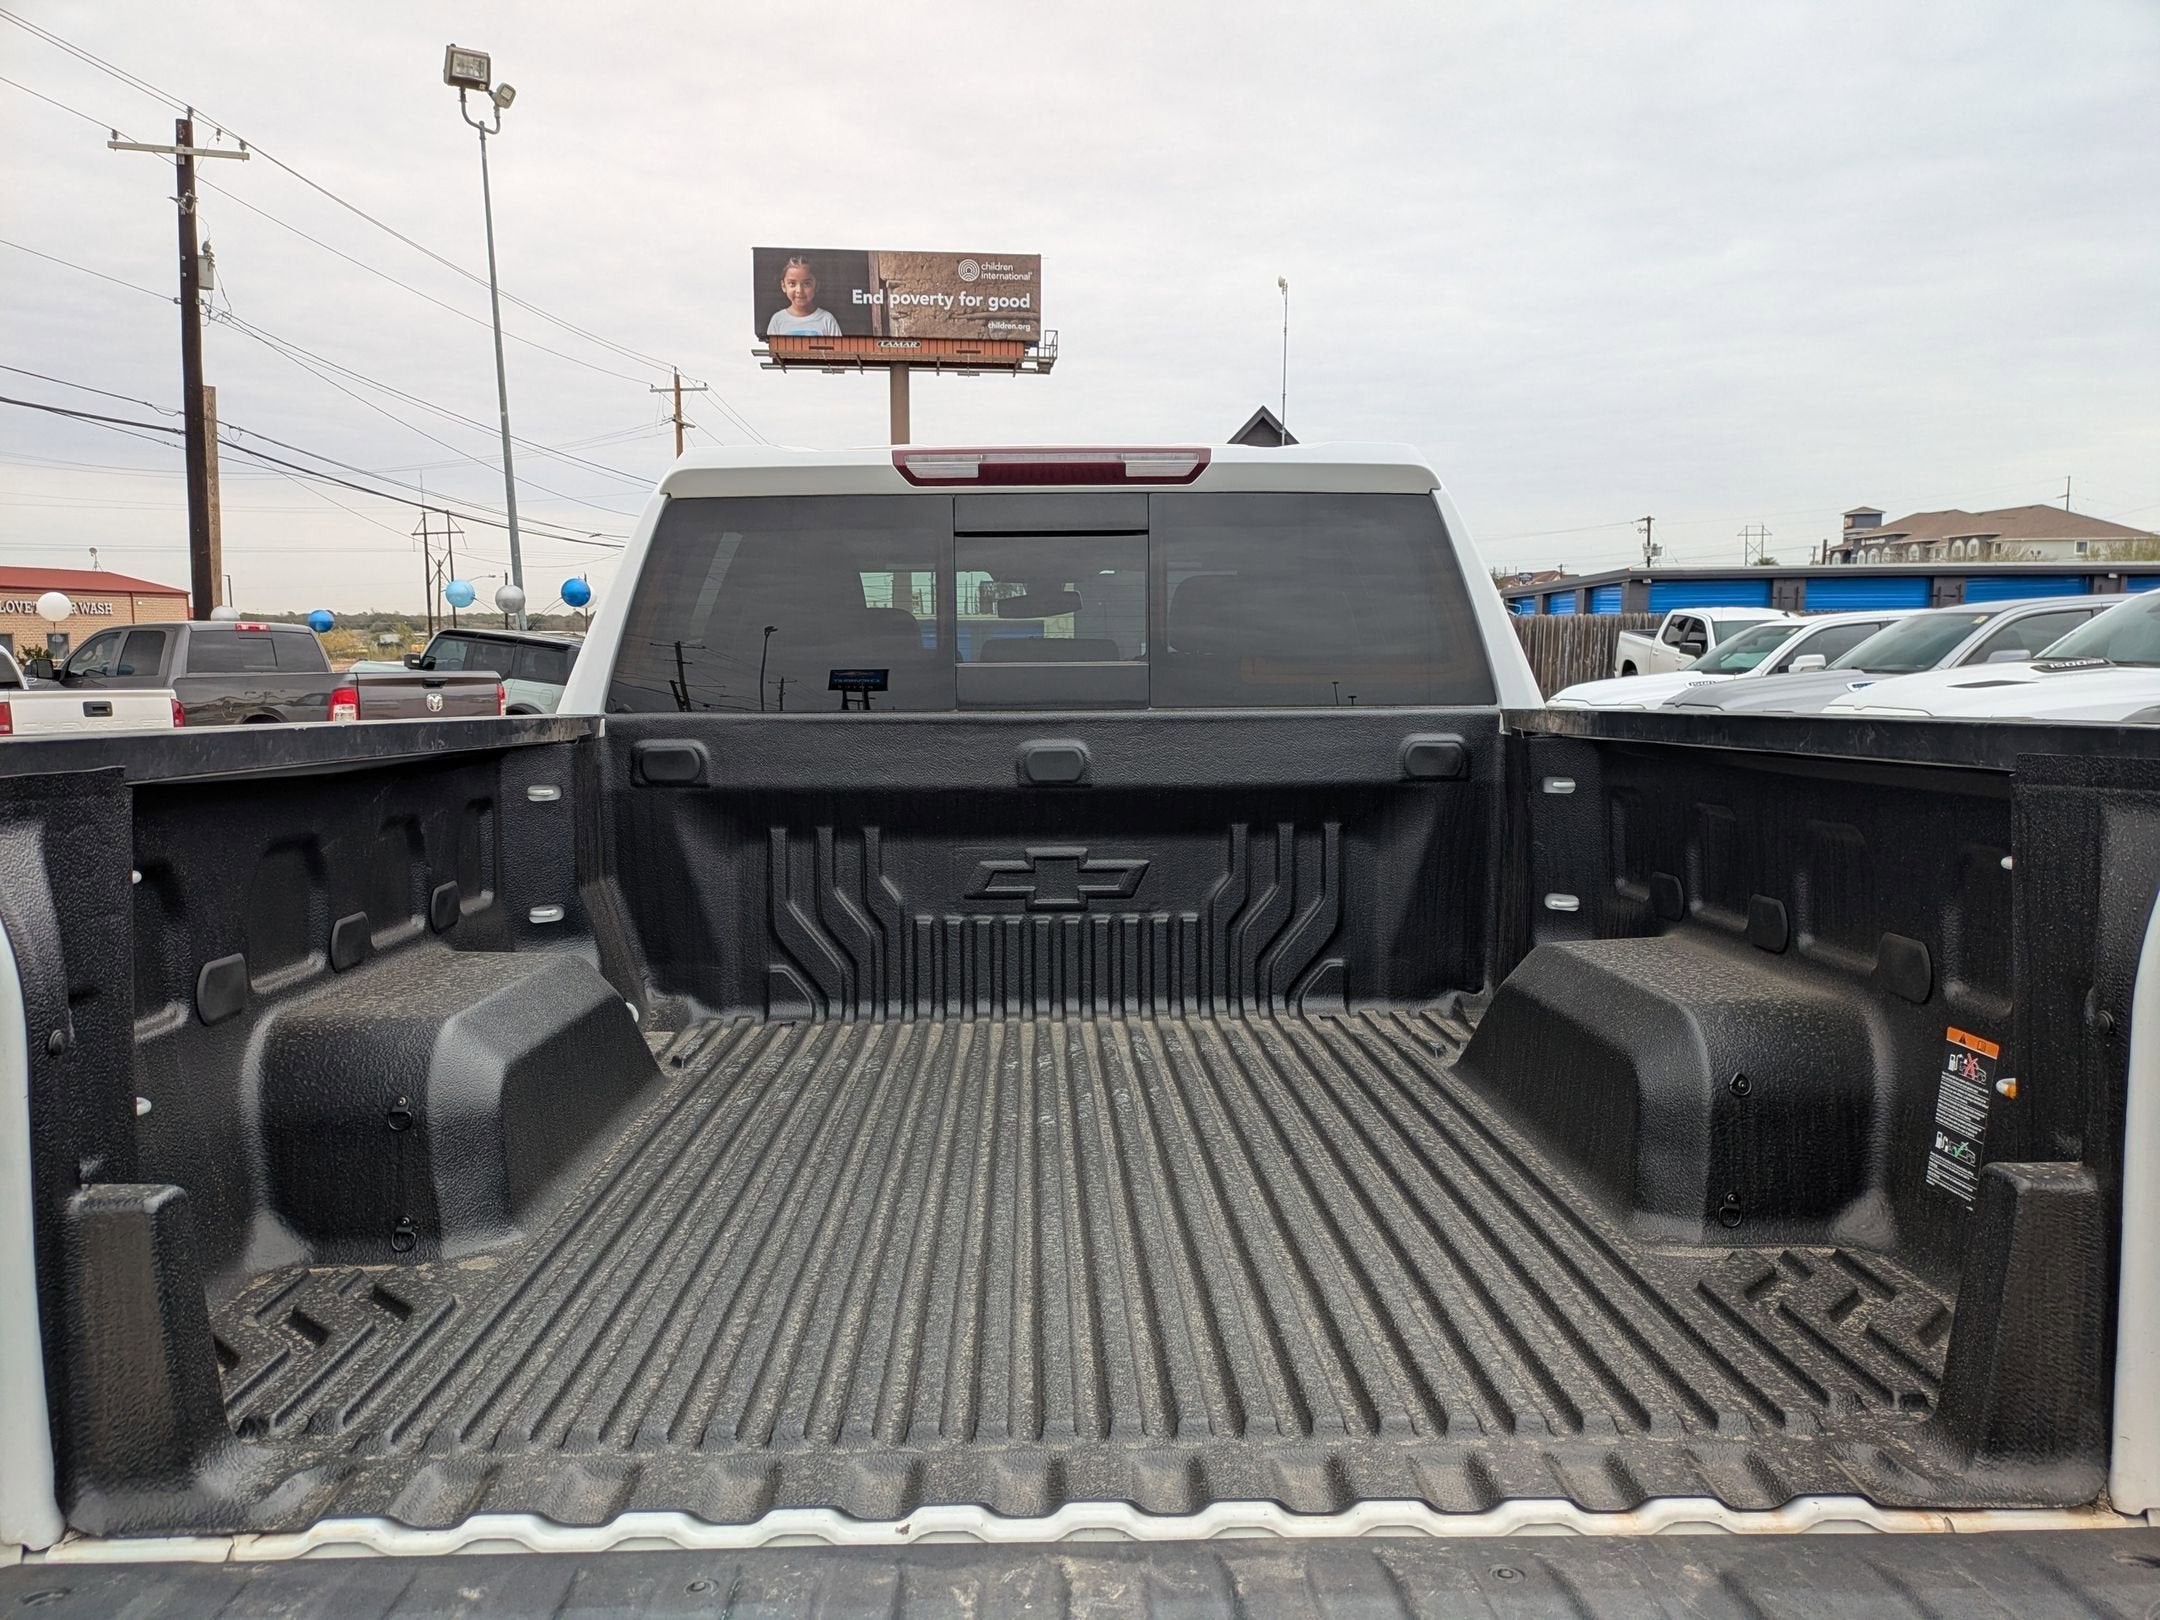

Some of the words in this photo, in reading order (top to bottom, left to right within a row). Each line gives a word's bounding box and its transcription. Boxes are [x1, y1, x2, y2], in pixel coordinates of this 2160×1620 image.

[981, 262, 1013, 271] children
[981, 271, 1031, 280] international
[852, 289, 884, 304] End
[890, 292, 954, 310] poverty
[959, 291, 983, 306] for
[988, 293, 1030, 311] good
[987, 321, 1031, 332] children.org
[79, 602, 113, 614] WASH
